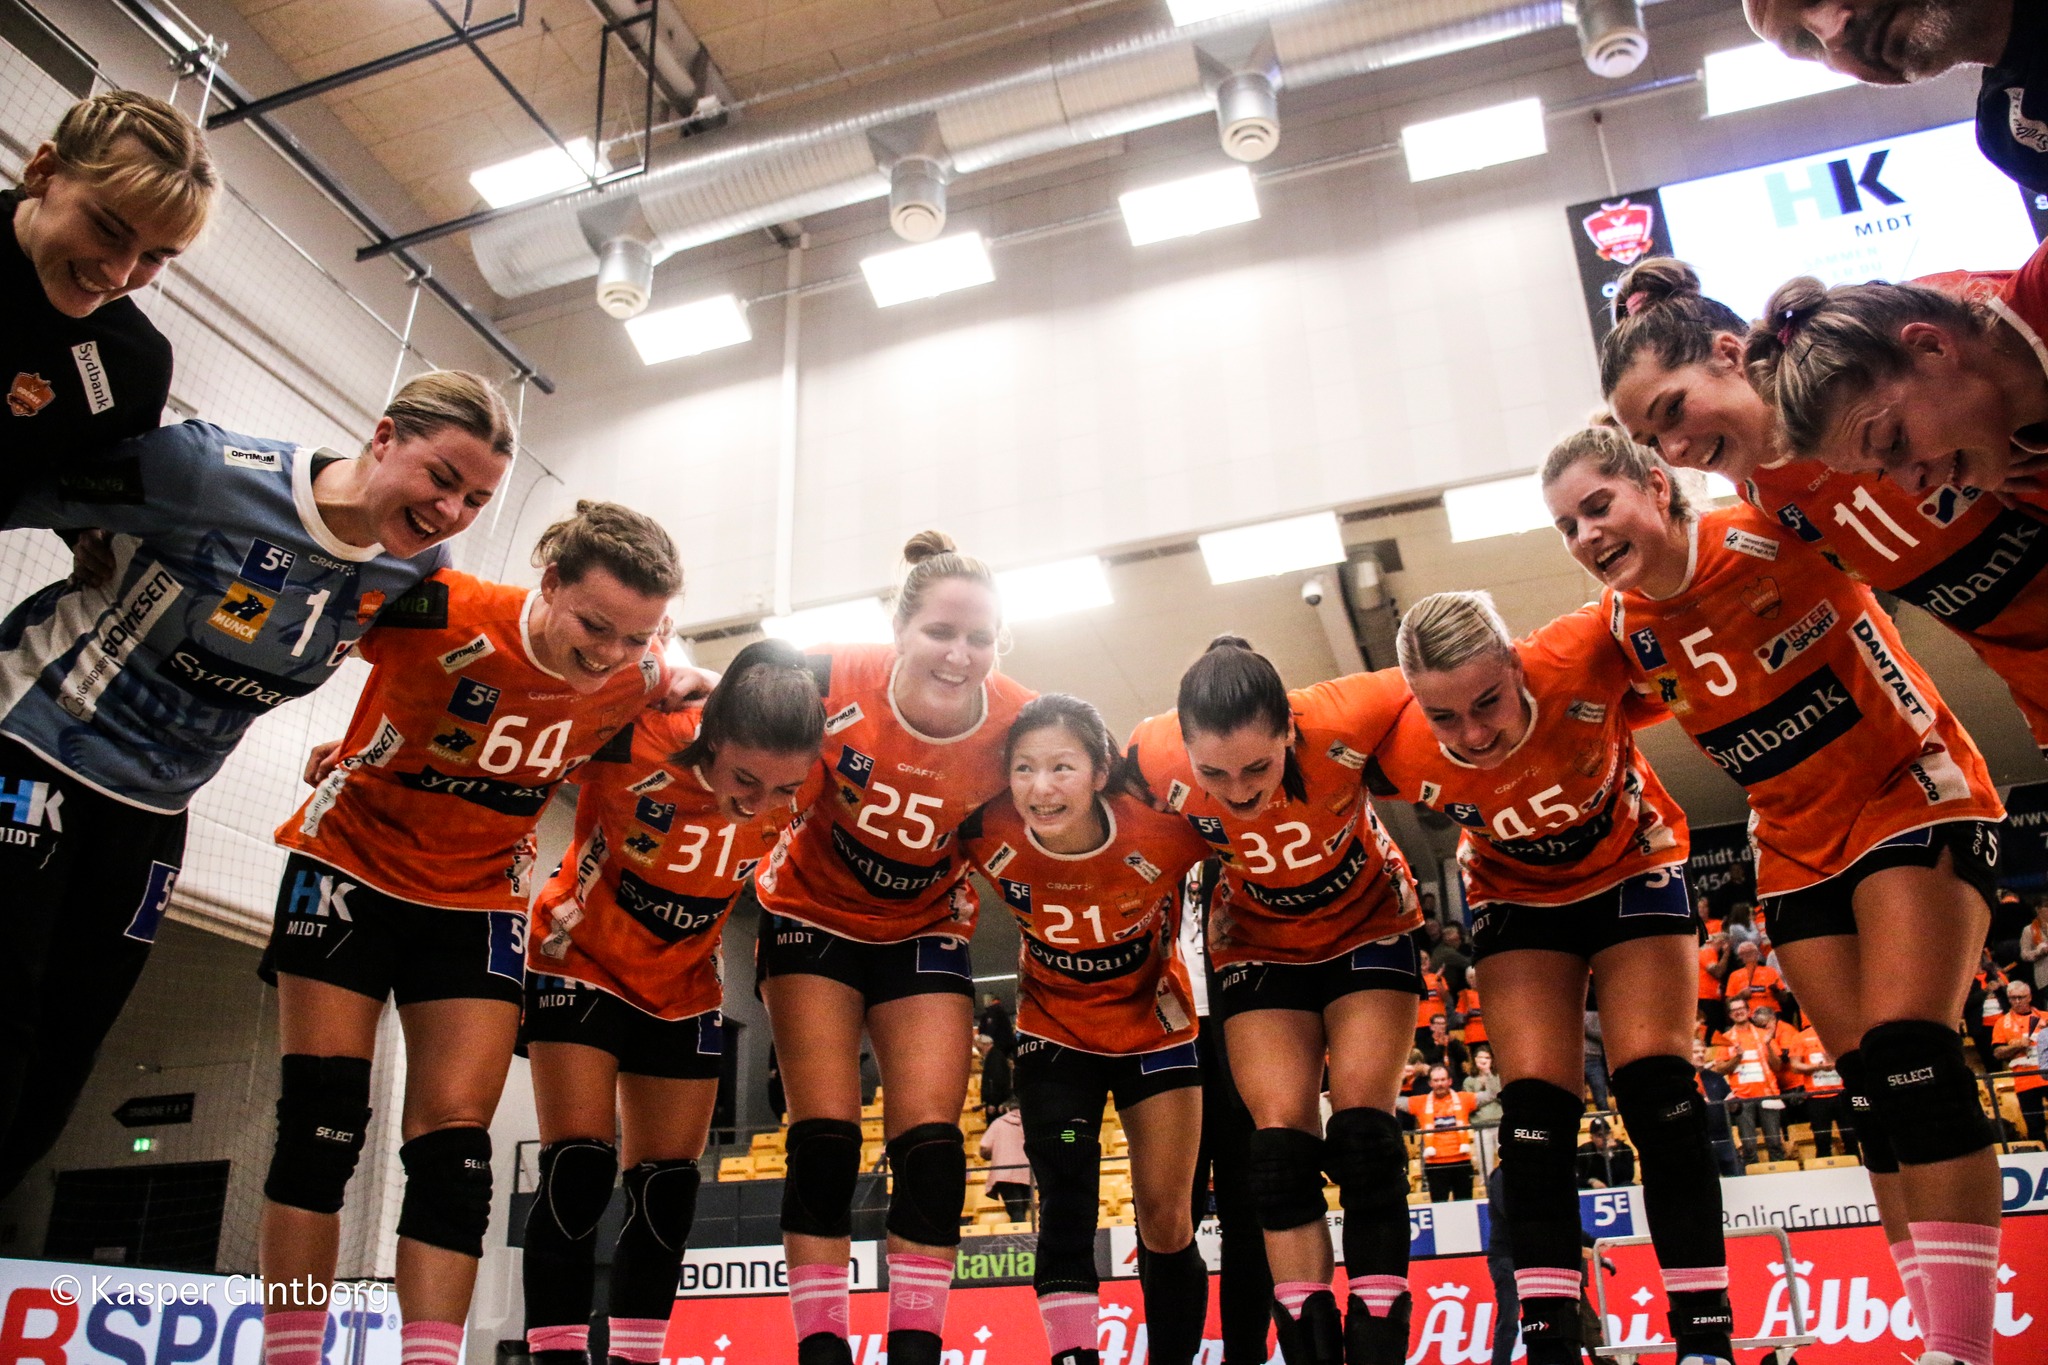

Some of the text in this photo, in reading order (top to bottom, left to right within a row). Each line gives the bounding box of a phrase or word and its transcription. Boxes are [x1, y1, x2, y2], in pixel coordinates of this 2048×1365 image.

[1764, 149, 1905, 228] HK
[1855, 214, 1913, 237] MIDT
[78, 343, 108, 410] Sydbank
[231, 449, 275, 464] OPTIMUM
[1834, 486, 1921, 562] 11
[260, 547, 292, 571] 5E
[309, 554, 347, 574] CRAFT
[1922, 523, 2041, 616] dbank
[212, 612, 258, 640] MUNCK
[290, 588, 331, 657] 1
[1785, 604, 1830, 642] INTER
[1792, 612, 1836, 652] SPORT
[445, 639, 485, 665] OPTIMUM
[1637, 629, 1656, 653] 5E
[1680, 627, 1737, 697] 5
[1853, 618, 1926, 716] DANTAET
[173, 650, 298, 707] Sydba
[467, 685, 498, 706] 5E
[826, 706, 857, 729] OPTIMUM
[1706, 684, 1848, 774] Sydbank
[478, 715, 573, 778] 64
[849, 753, 872, 772] 5E
[897, 763, 936, 779] CRAFT
[648, 802, 675, 818] 5E
[857, 781, 944, 849] 25
[1493, 784, 1579, 840] 45
[1198, 818, 1221, 833] 5E
[667, 823, 737, 877] 31
[1240, 821, 1322, 874] 32
[288, 870, 357, 922] HK
[1009, 882, 1030, 900] 5E
[1046, 882, 1082, 892] CRAFT
[620, 880, 726, 930] Sydba
[286, 920, 328, 938] MIDT
[1042, 904, 1106, 944] 21
[777, 932, 814, 946] MIDT
[538, 994, 577, 1010] MIDT
[1887, 1066, 1934, 1087] SELECT
[1851, 1096, 1870, 1107] SEL
[315, 1126, 354, 1143] SELECT
[464, 1157, 488, 1169] SELE
[1594, 1196, 1630, 1227] 5E
[679, 1255, 859, 1290] BONNEN
[955, 1247, 1035, 1280] tavia
